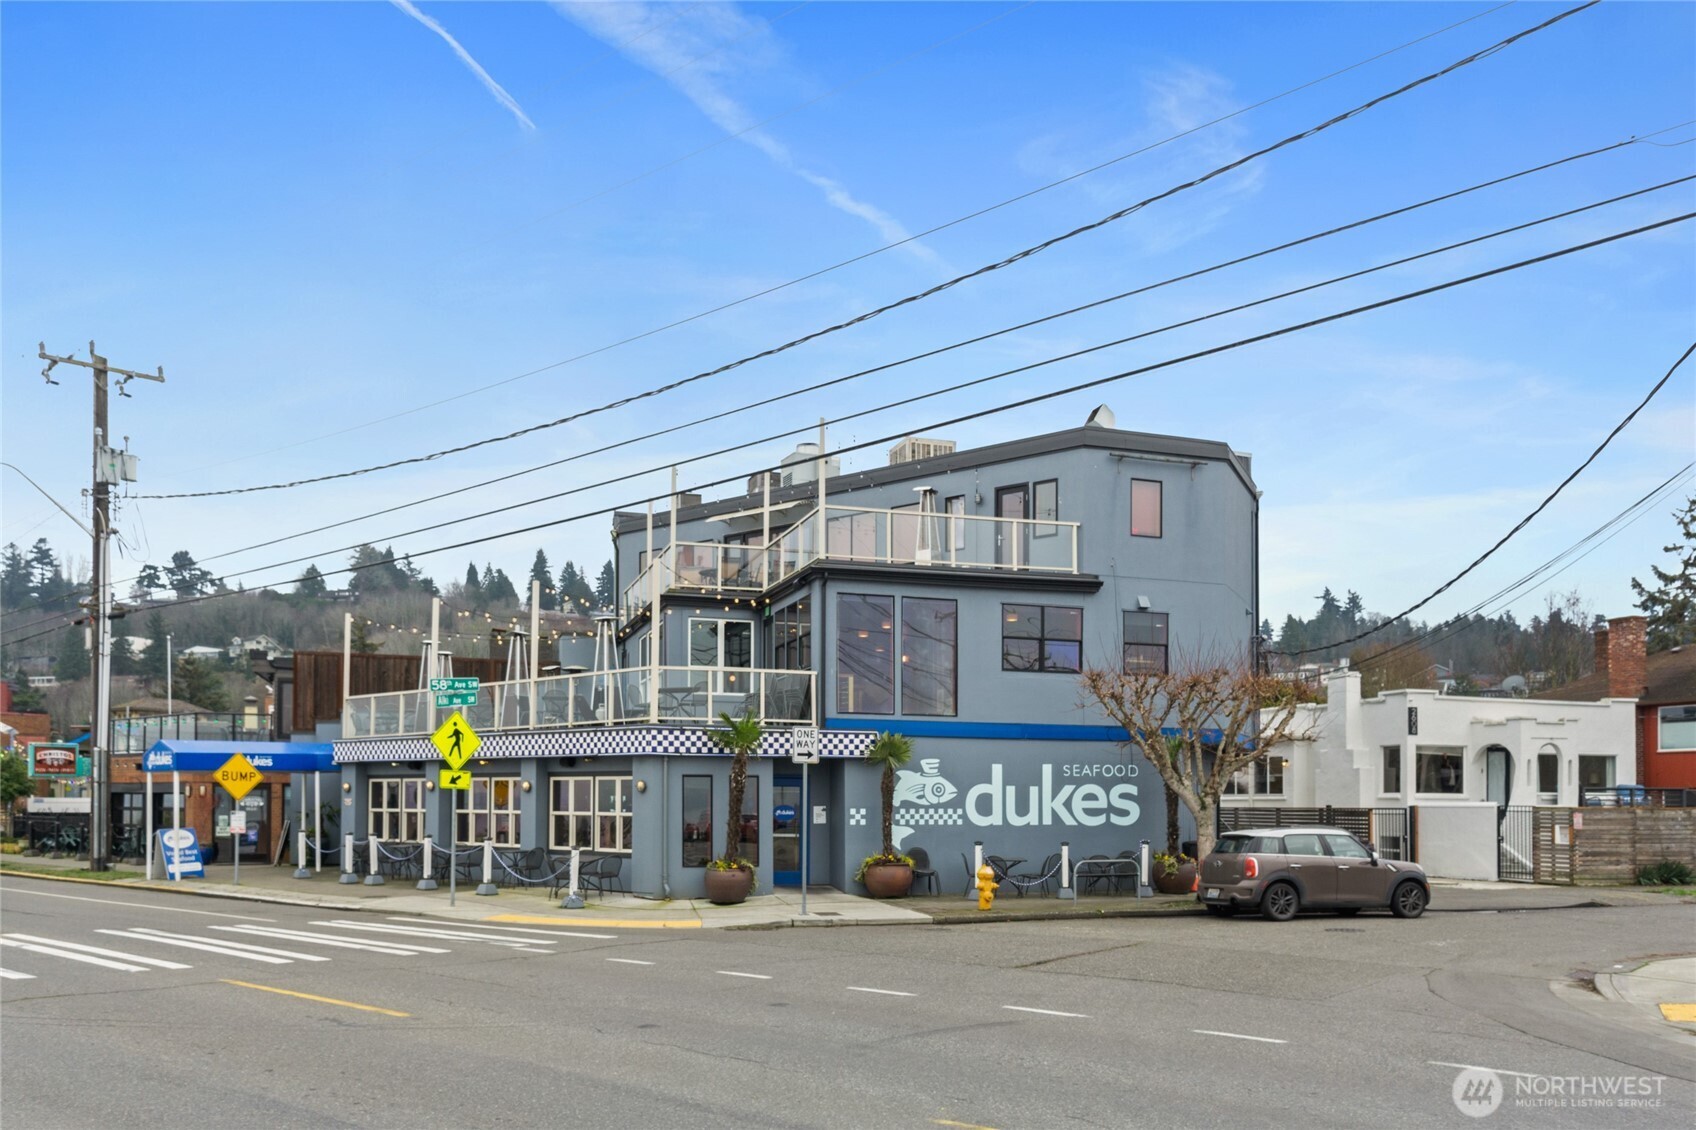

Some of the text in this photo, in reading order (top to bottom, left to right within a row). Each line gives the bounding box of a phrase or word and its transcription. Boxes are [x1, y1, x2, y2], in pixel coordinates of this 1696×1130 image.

[438, 695, 449, 705] Alki
[796, 729, 815, 738] ONE
[796, 740, 815, 748] WAY
[221, 770, 257, 781] BUMP
[1063, 764, 1139, 777] SEAFOOD
[965, 763, 1141, 827] dukes
